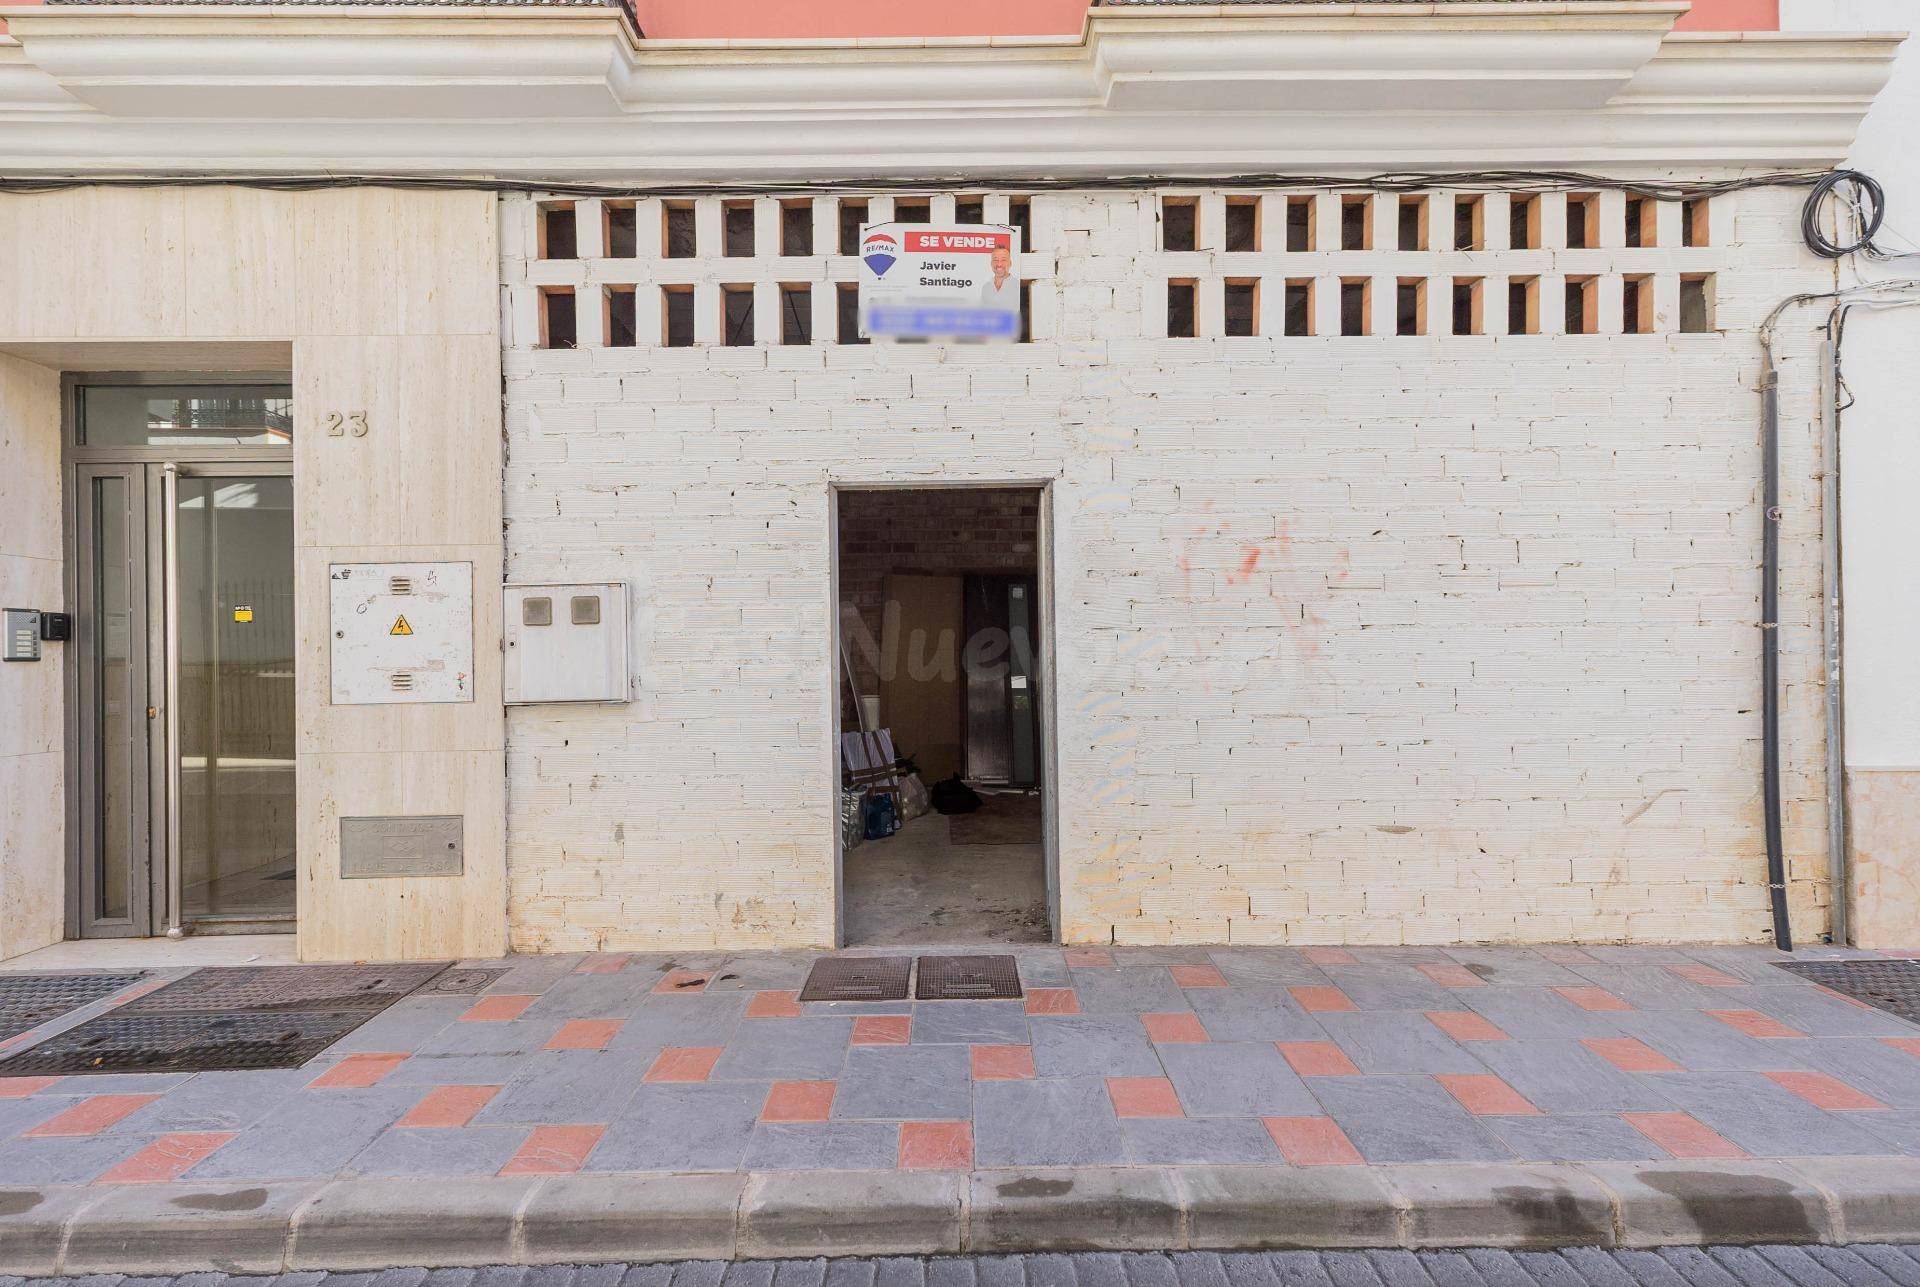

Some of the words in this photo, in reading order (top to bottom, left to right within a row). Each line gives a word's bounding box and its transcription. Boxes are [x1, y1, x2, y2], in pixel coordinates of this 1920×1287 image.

[920, 235, 940, 248] SE
[942, 236, 996, 249] VENDE
[866, 243, 895, 254] RE/MAX
[919, 261, 957, 271] Javier
[919, 276, 973, 288] Santiago
[326, 409, 369, 438] 23
